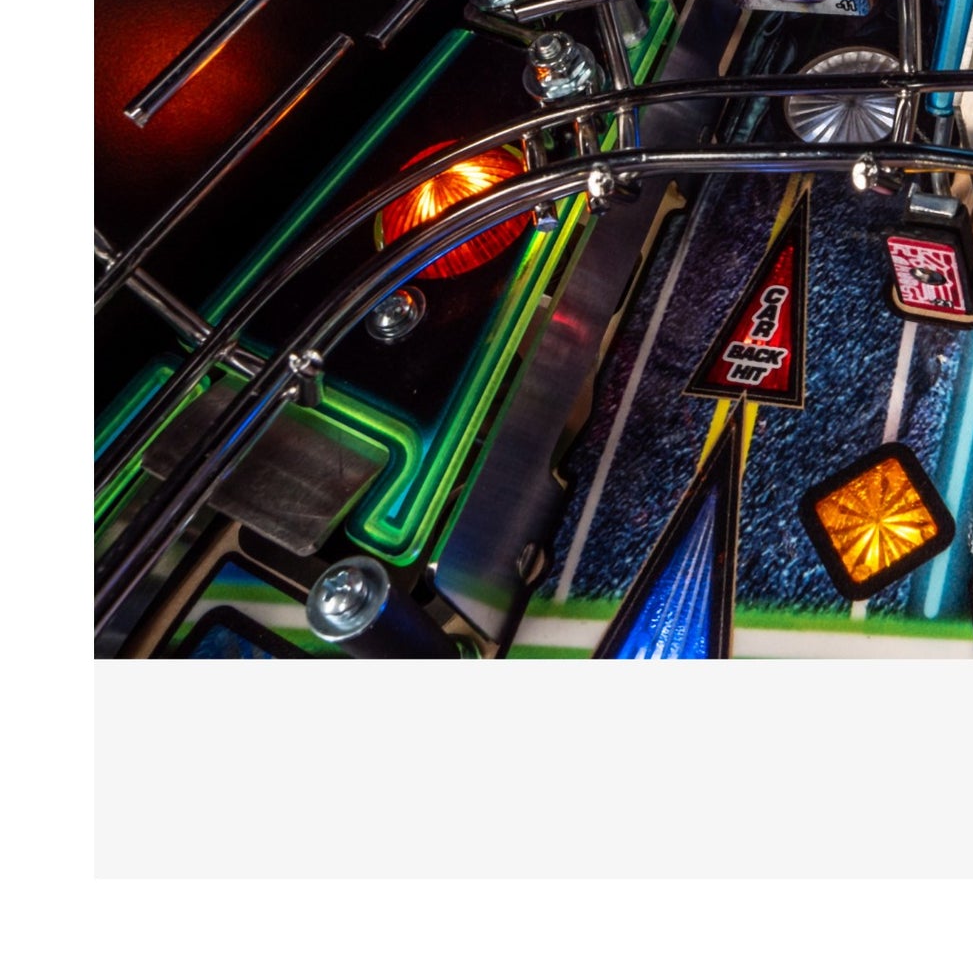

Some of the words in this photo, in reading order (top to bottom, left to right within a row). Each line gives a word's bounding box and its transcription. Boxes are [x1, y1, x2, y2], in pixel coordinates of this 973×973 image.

[752, 287, 787, 339] CAR
[725, 343, 787, 366] BACK
[729, 364, 769, 382] HIT
